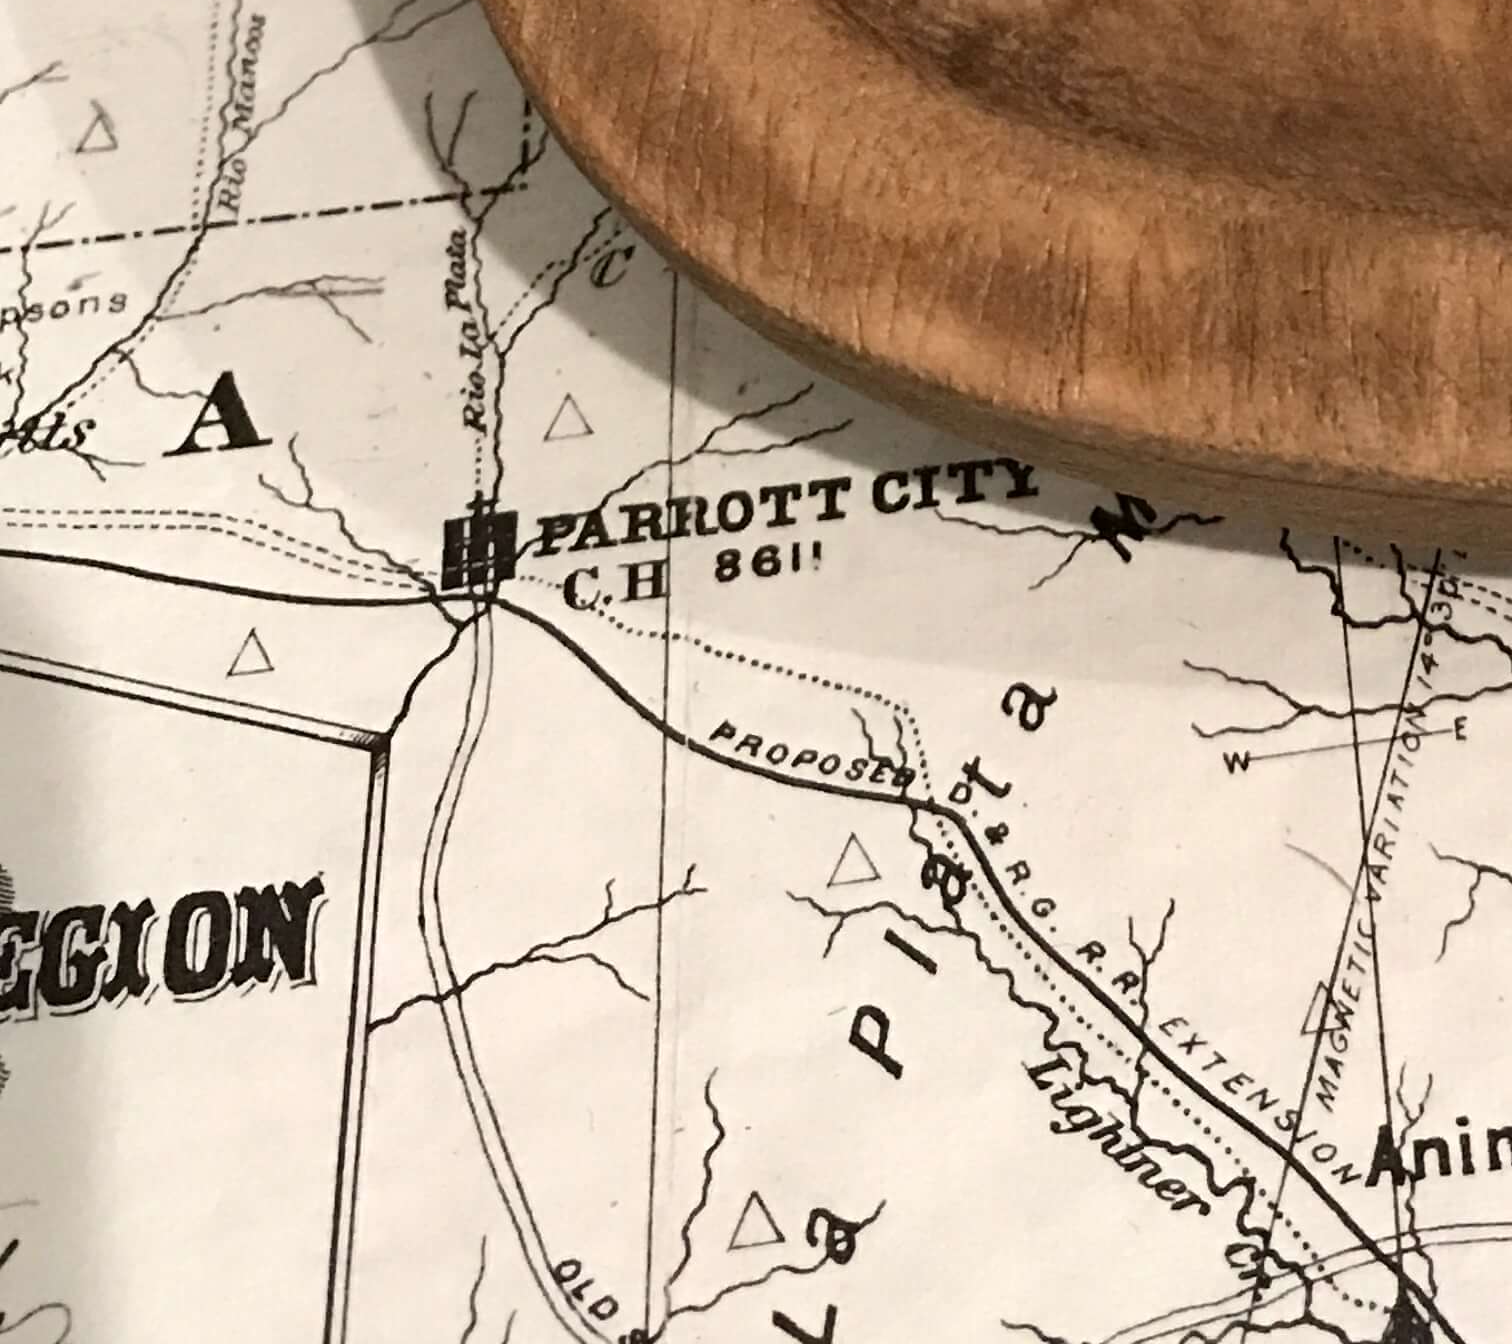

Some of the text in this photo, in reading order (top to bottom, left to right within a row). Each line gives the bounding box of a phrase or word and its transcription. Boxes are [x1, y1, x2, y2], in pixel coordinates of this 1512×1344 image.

[217, 159, 247, 220] Rio
[162, 370, 273, 457] A
[460, 371, 488, 437] Rio
[532, 457, 1040, 559] PARROTT CITY
[1316, 918, 1376, 1112] MAGNETIC
[1366, 701, 1428, 902] VARIATION
[709, 720, 917, 790] PROPOSED
[1160, 1016, 1363, 1188] EXTENSION
[1022, 1053, 1211, 1216] Lightner
[553, 1259, 620, 1320] OLD
